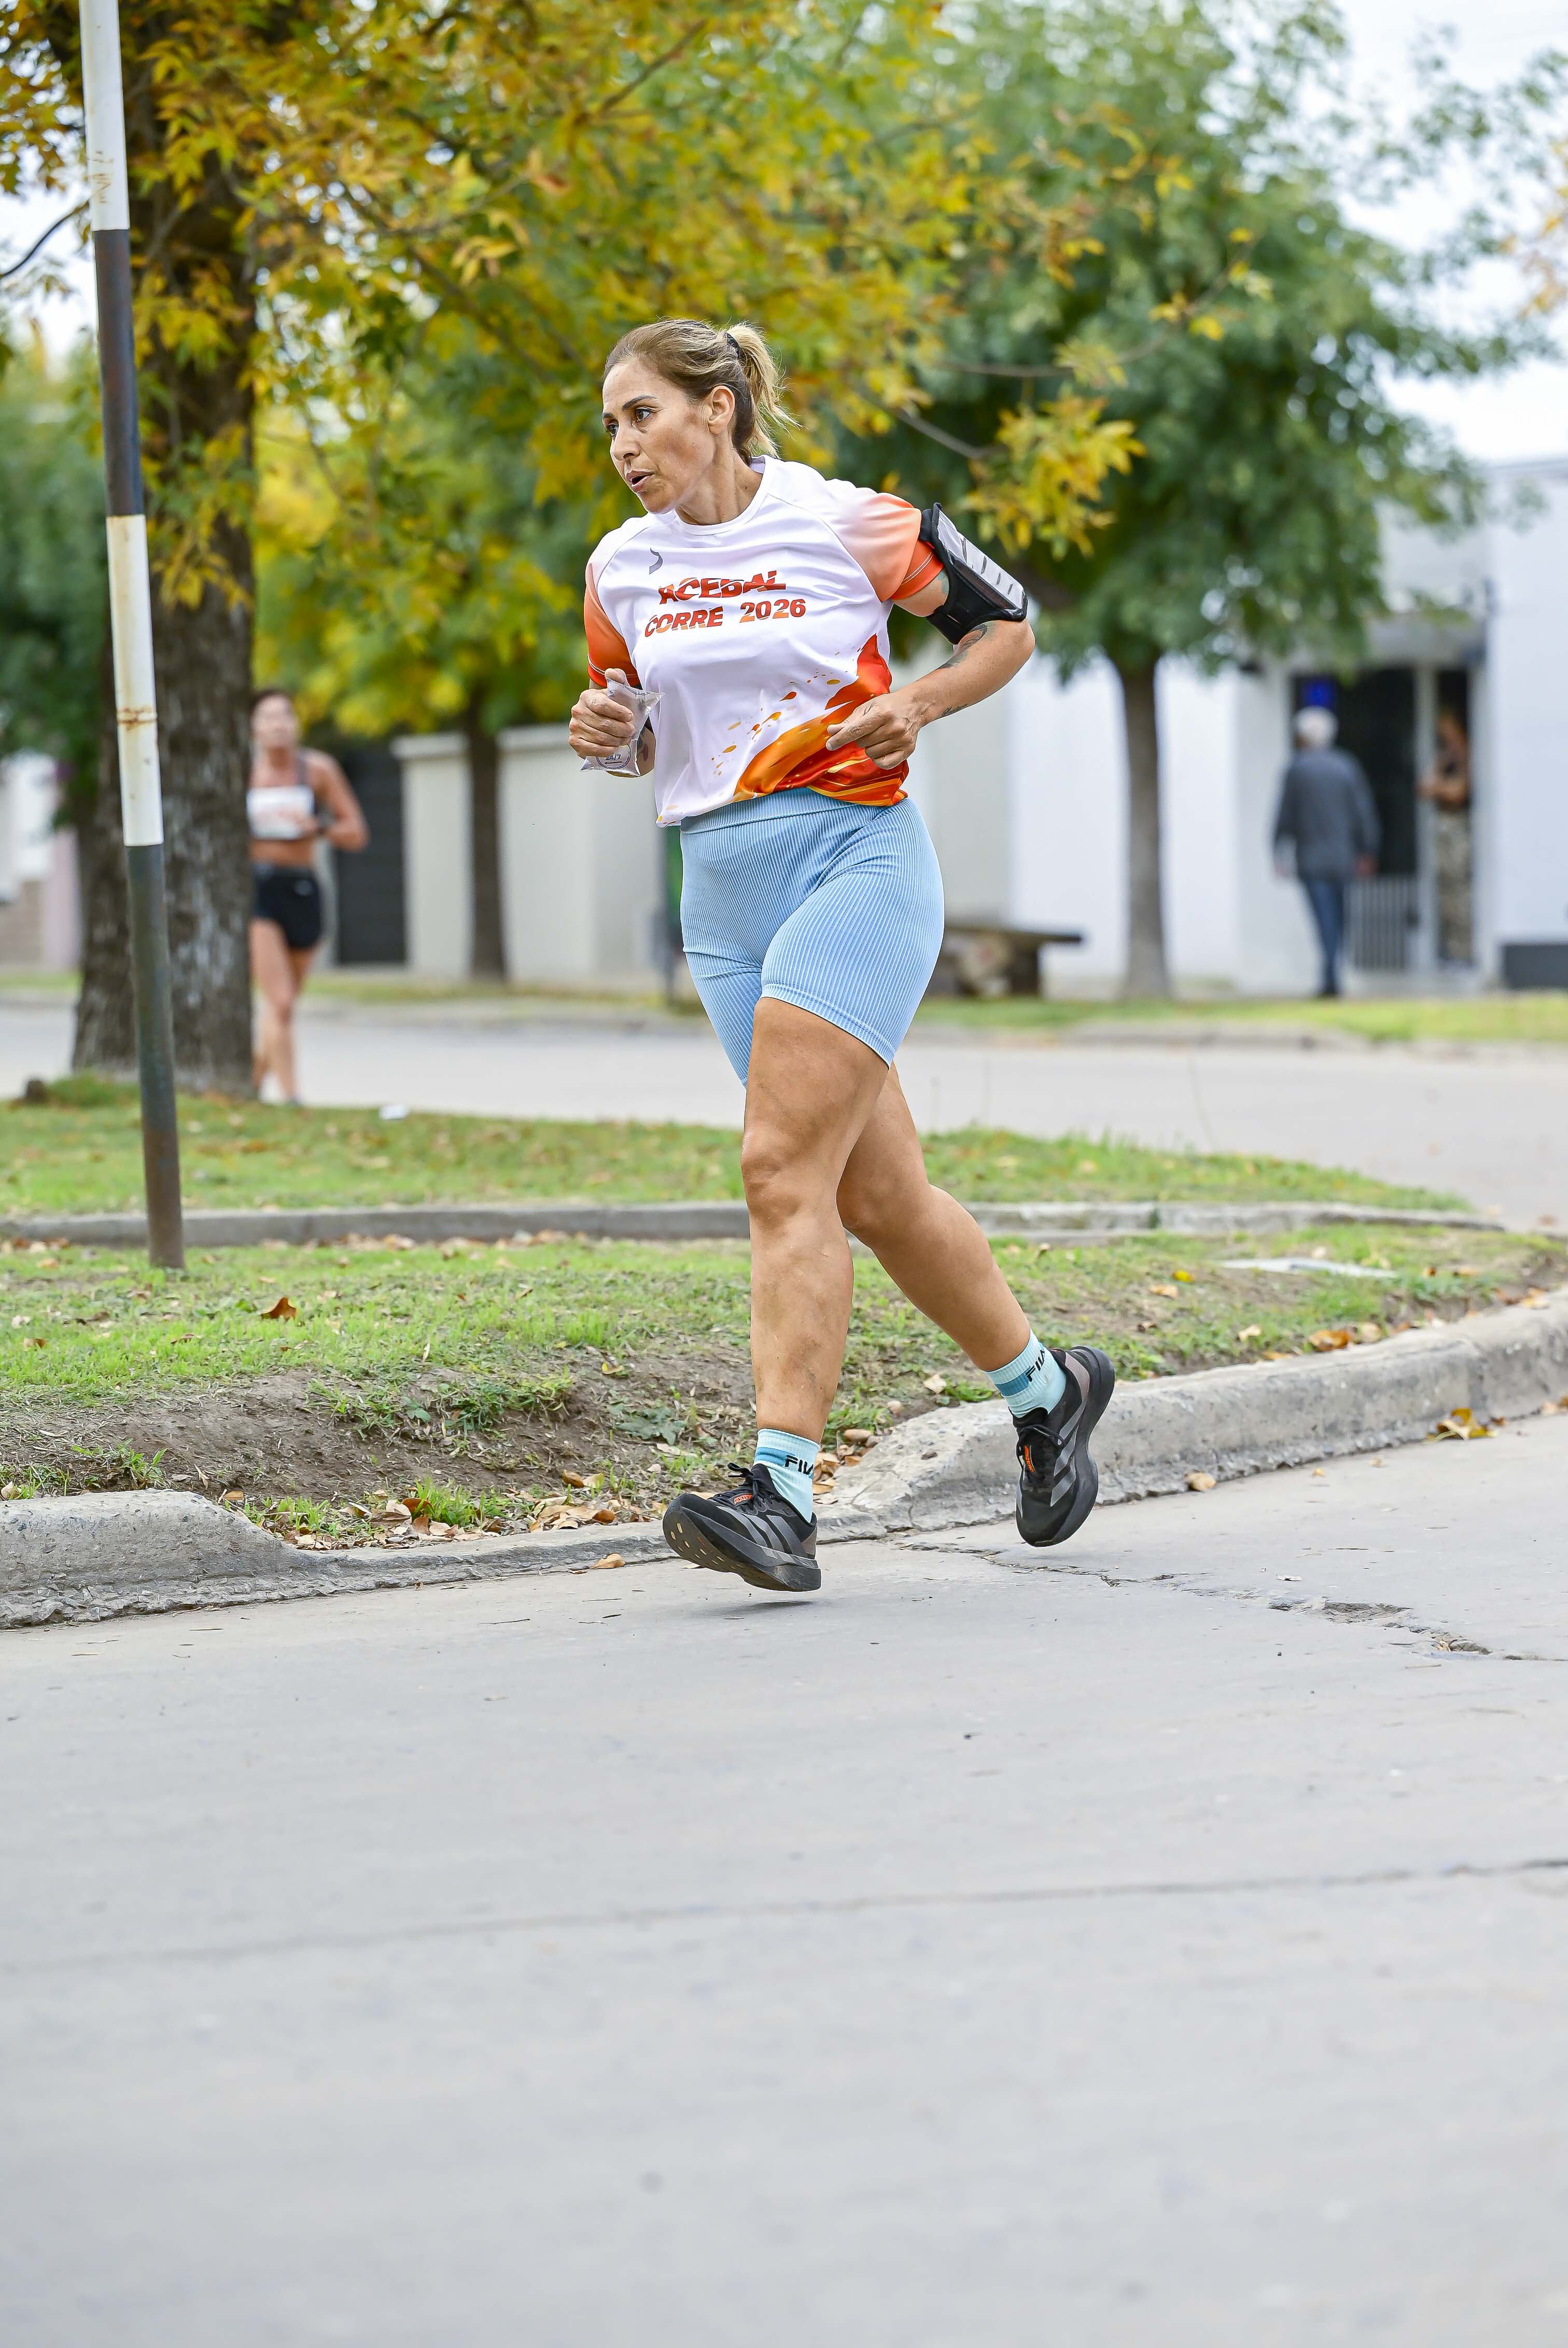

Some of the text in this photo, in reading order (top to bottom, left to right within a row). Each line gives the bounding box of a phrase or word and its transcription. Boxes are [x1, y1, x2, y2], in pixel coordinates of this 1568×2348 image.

[659, 570, 786, 605] ACEBAL
[645, 599, 806, 637] CORRE 2026
